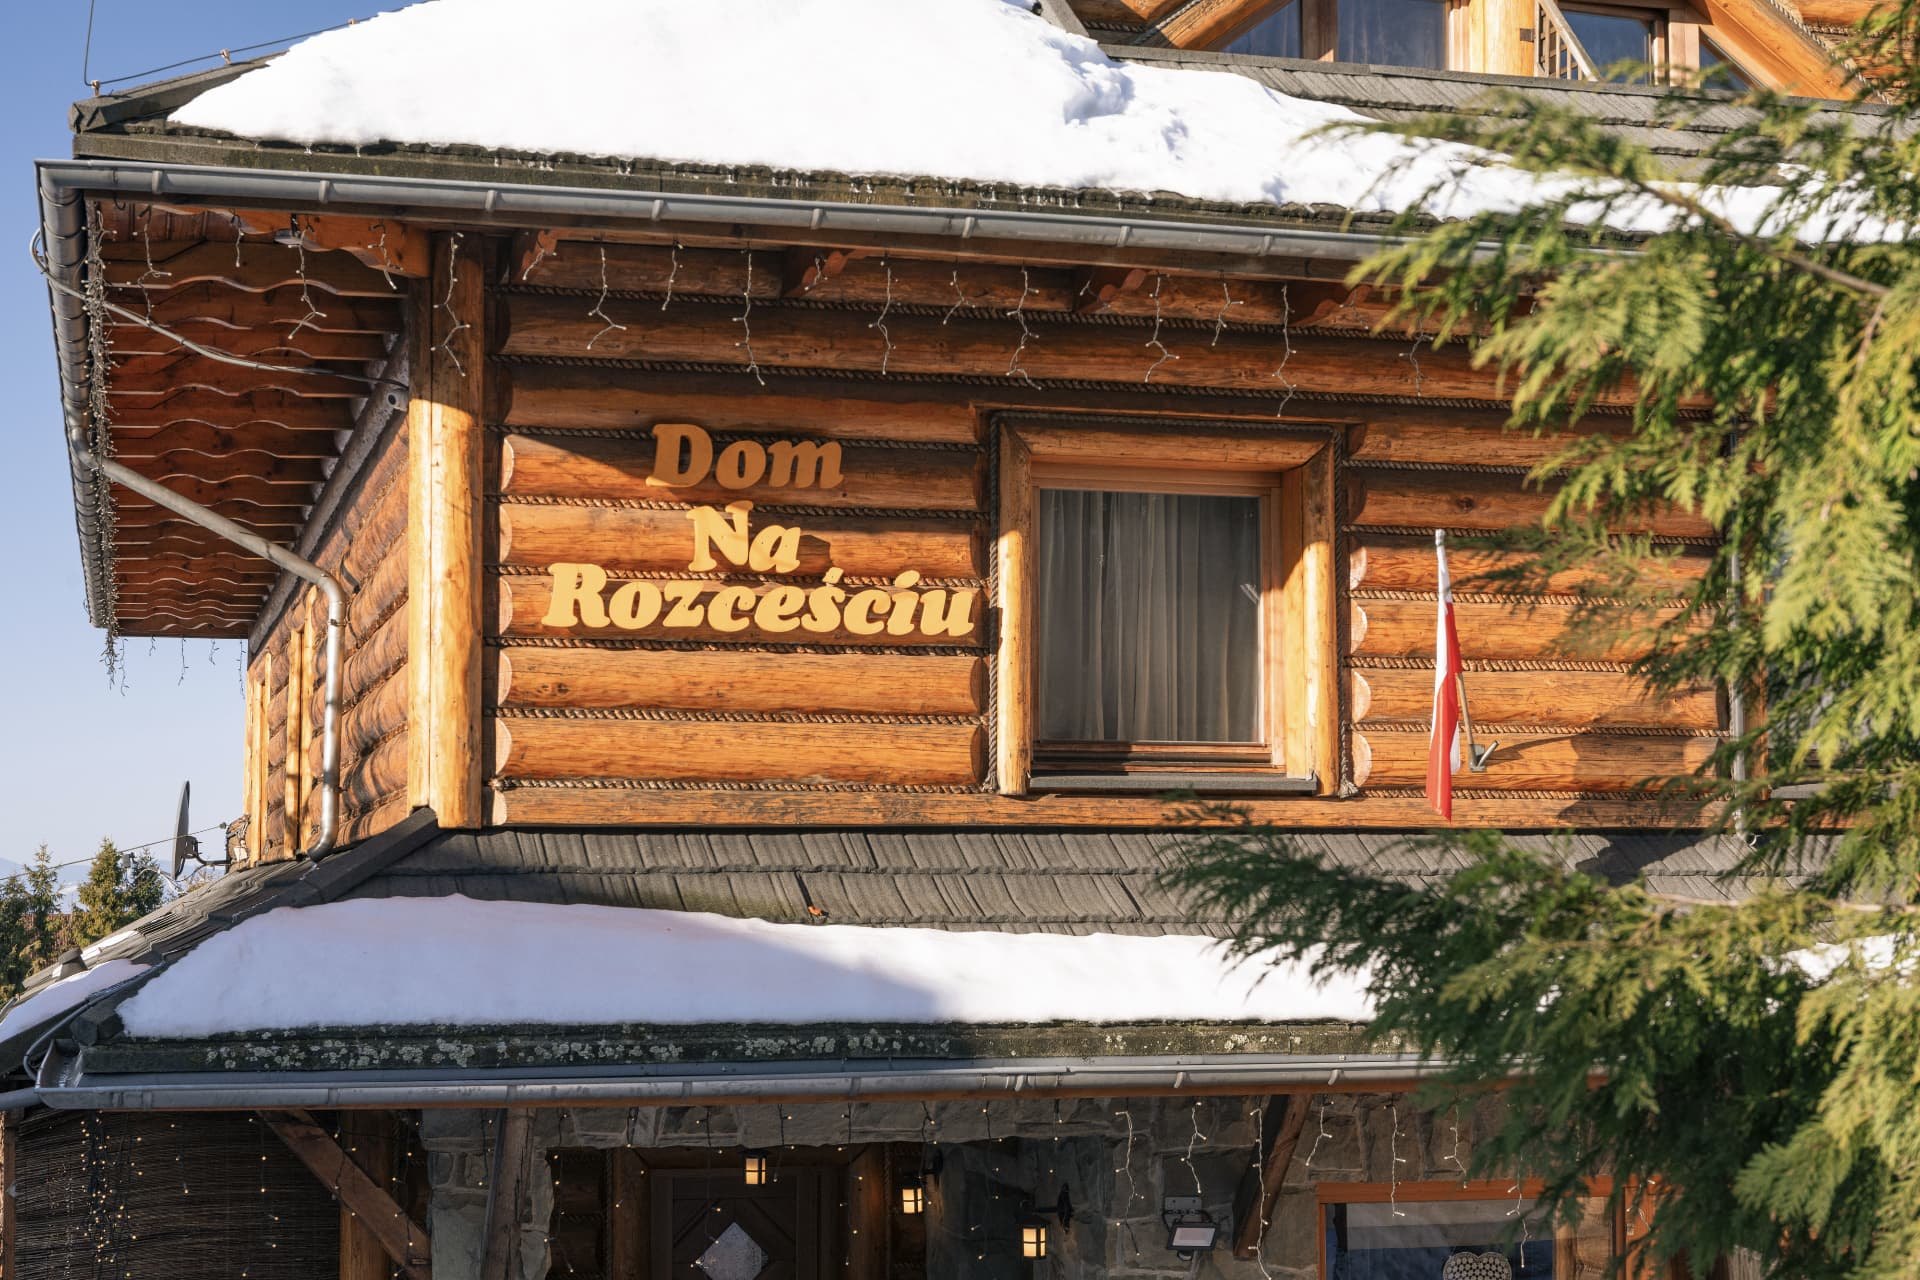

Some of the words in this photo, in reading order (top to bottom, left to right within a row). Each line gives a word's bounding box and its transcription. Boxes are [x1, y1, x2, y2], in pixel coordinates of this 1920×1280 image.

[645, 423, 844, 489] Dom
[687, 500, 801, 574] Na
[541, 562, 975, 636] Rozceściu
